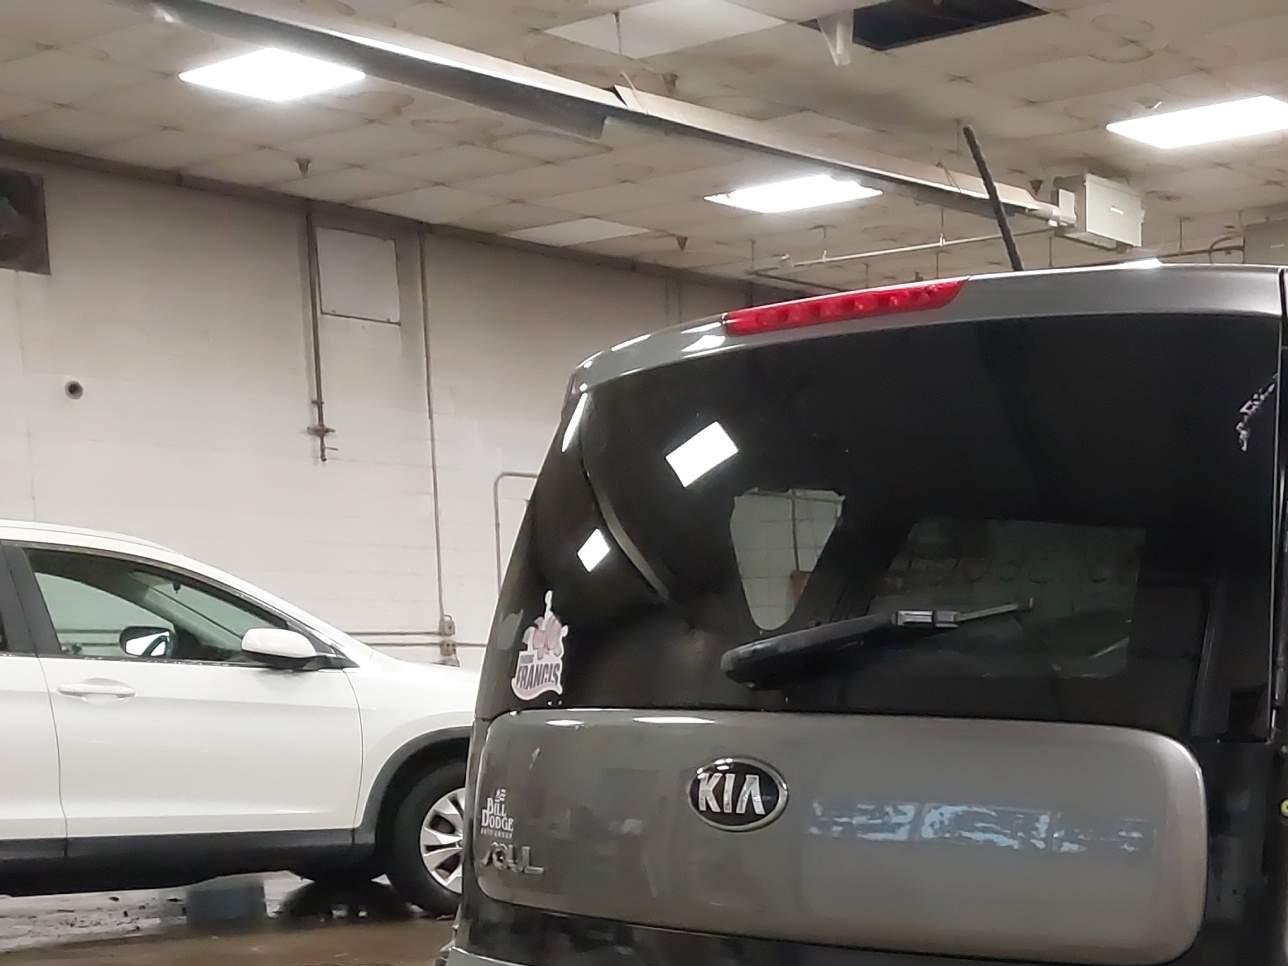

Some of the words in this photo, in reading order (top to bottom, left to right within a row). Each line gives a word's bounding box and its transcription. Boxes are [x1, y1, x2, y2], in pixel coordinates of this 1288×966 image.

[698, 772, 766, 816] KIA
[487, 797, 507, 817] BILL
[481, 808, 514, 832] DODGE
